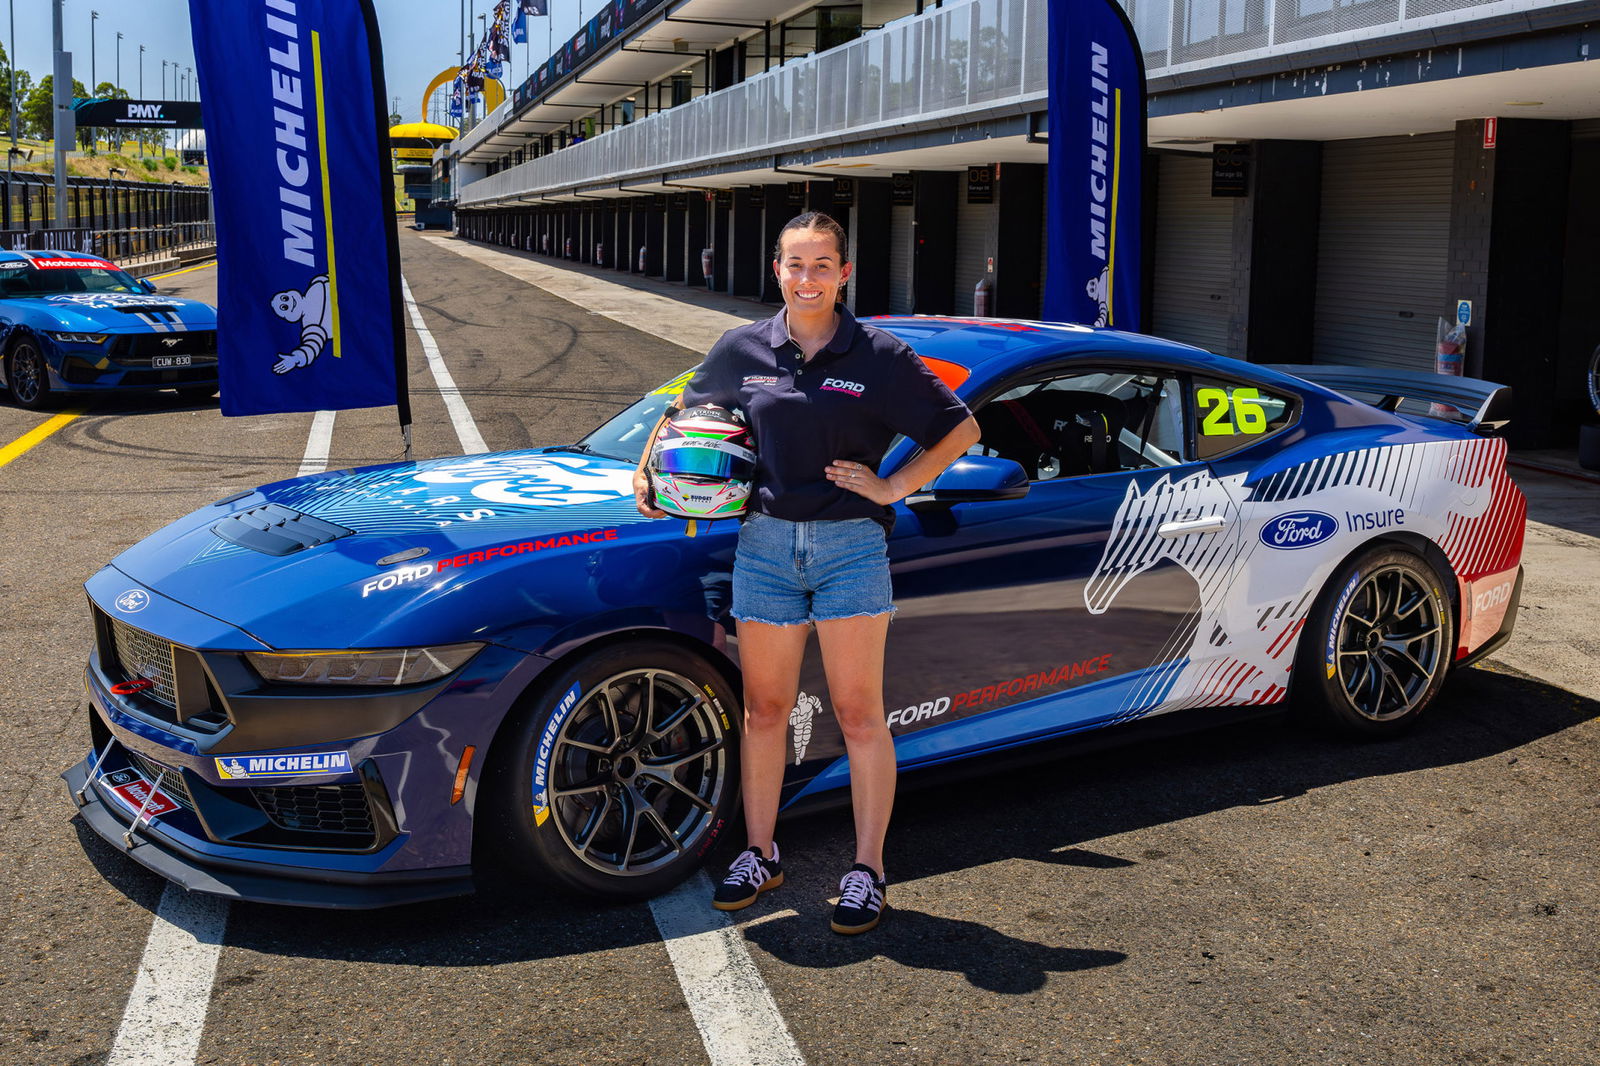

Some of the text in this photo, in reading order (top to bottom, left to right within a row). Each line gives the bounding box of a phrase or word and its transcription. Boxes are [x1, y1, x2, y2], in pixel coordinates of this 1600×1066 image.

[1091, 41, 1109, 261] MICHELIN
[38, 260, 107, 268] Motorcraft
[822, 377, 865, 393] FORD
[1197, 387, 1267, 436] 26
[1274, 508, 1405, 544] Ford Insure
[362, 529, 619, 598] FORD PERFORMANCE
[1329, 579, 1357, 649] MICHELIN
[1474, 582, 1511, 617] FORD
[886, 653, 1113, 730] FORD PERFORMANCE
[249, 754, 345, 771] MICHELIN
[535, 690, 577, 786] MICHELIN
